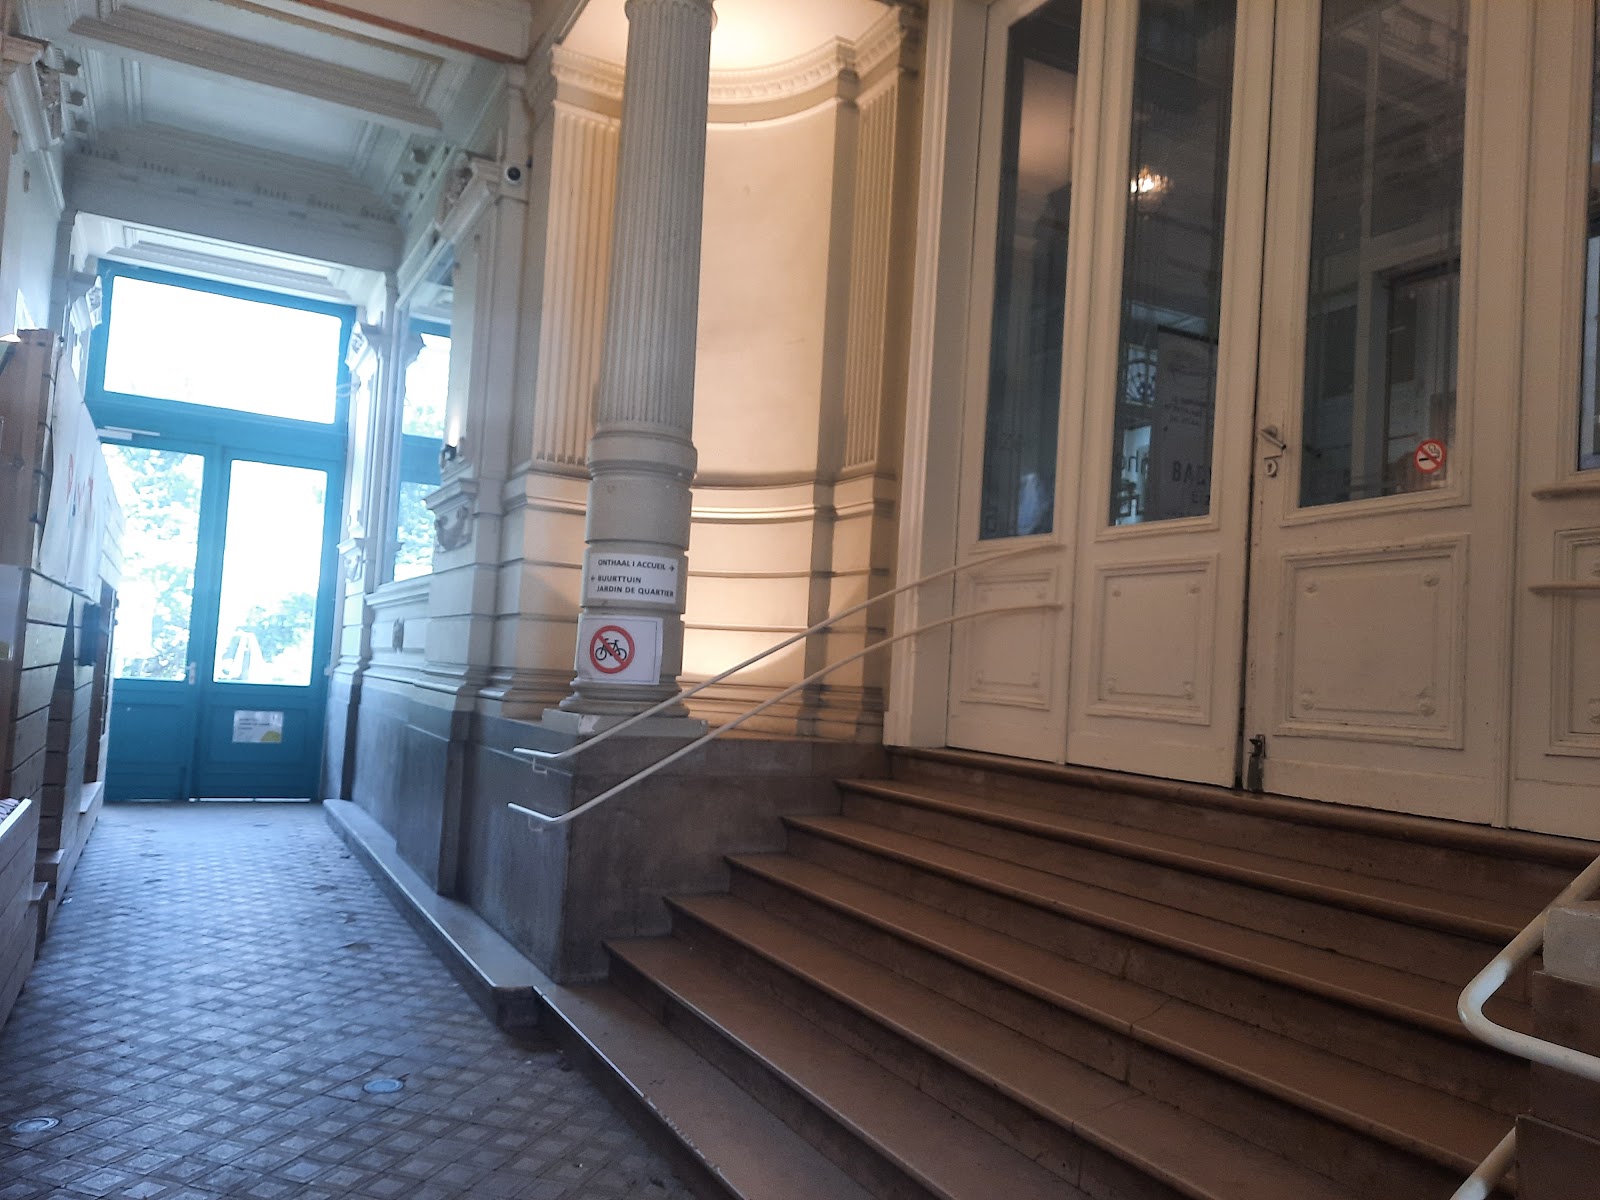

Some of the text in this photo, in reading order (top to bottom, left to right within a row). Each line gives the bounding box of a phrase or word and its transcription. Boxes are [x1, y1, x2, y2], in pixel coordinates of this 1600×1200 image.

[598, 559, 630, 567] ONTHAAL
[637, 561, 666, 570] ACCUEIL
[597, 575, 641, 583] BUURTTUIN
[638, 588, 674, 597] QUARTIER
